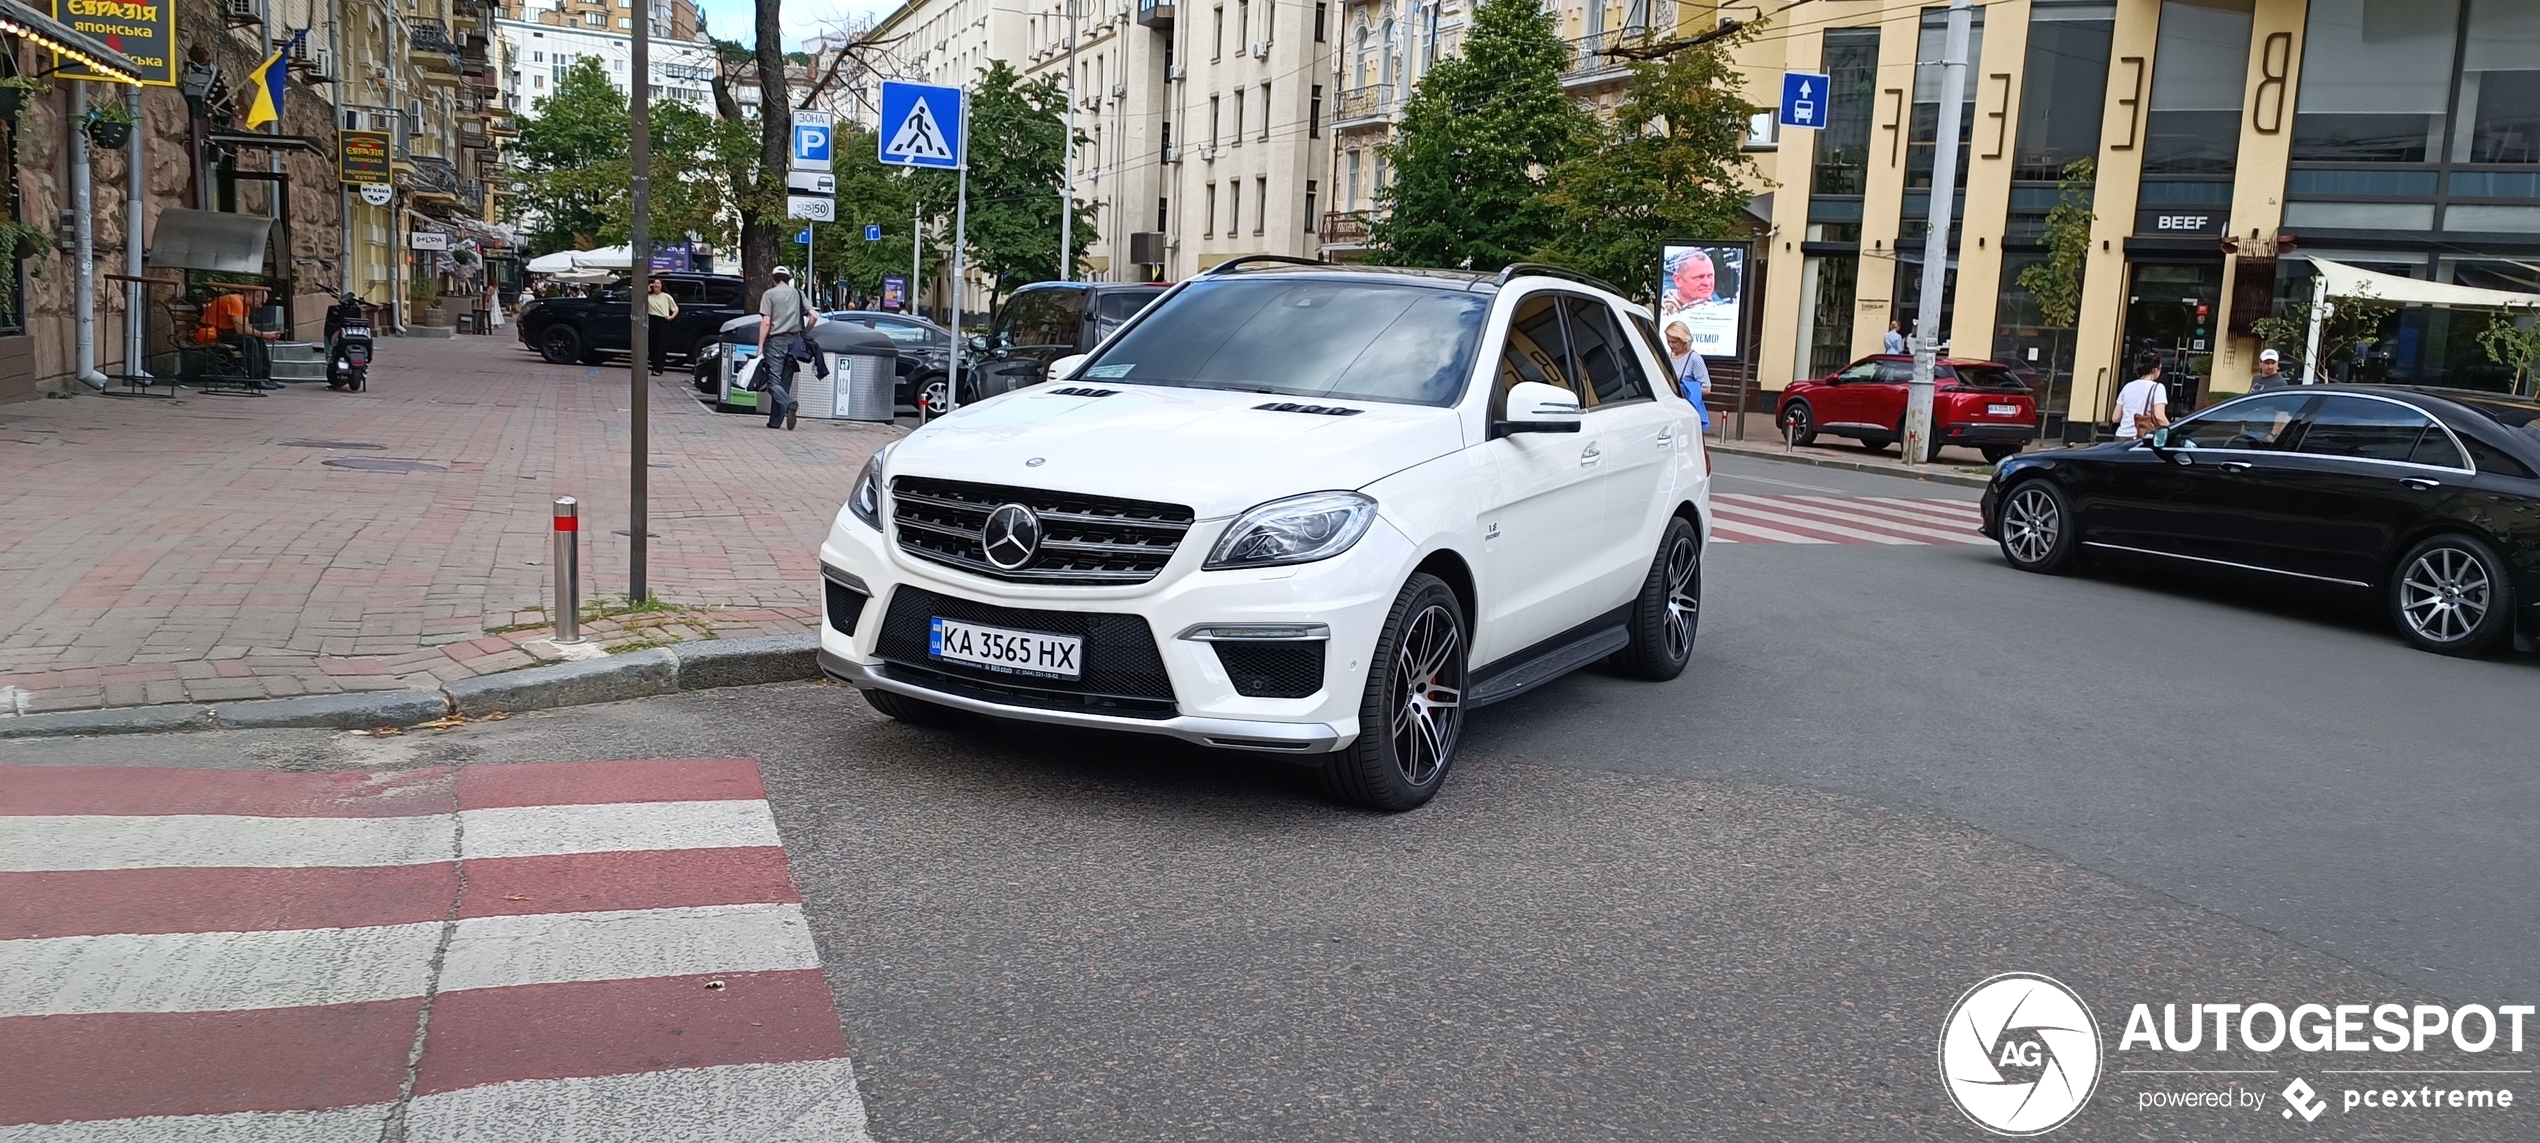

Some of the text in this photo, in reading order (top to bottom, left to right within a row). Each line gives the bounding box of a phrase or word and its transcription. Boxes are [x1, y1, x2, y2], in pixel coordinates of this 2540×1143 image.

[67, 0, 158, 22] ЄВРАЗІЯ
[75, 21, 153, 38] японська
[798, 113, 825, 124] ЗОНА
[801, 130, 826, 157] P
[804, 204, 812, 212] 25
[814, 204, 827, 214] 50
[2158, 215, 2208, 230] BEEF
[931, 640, 941, 650] UA
[943, 626, 1076, 669] KA 3565 HX
